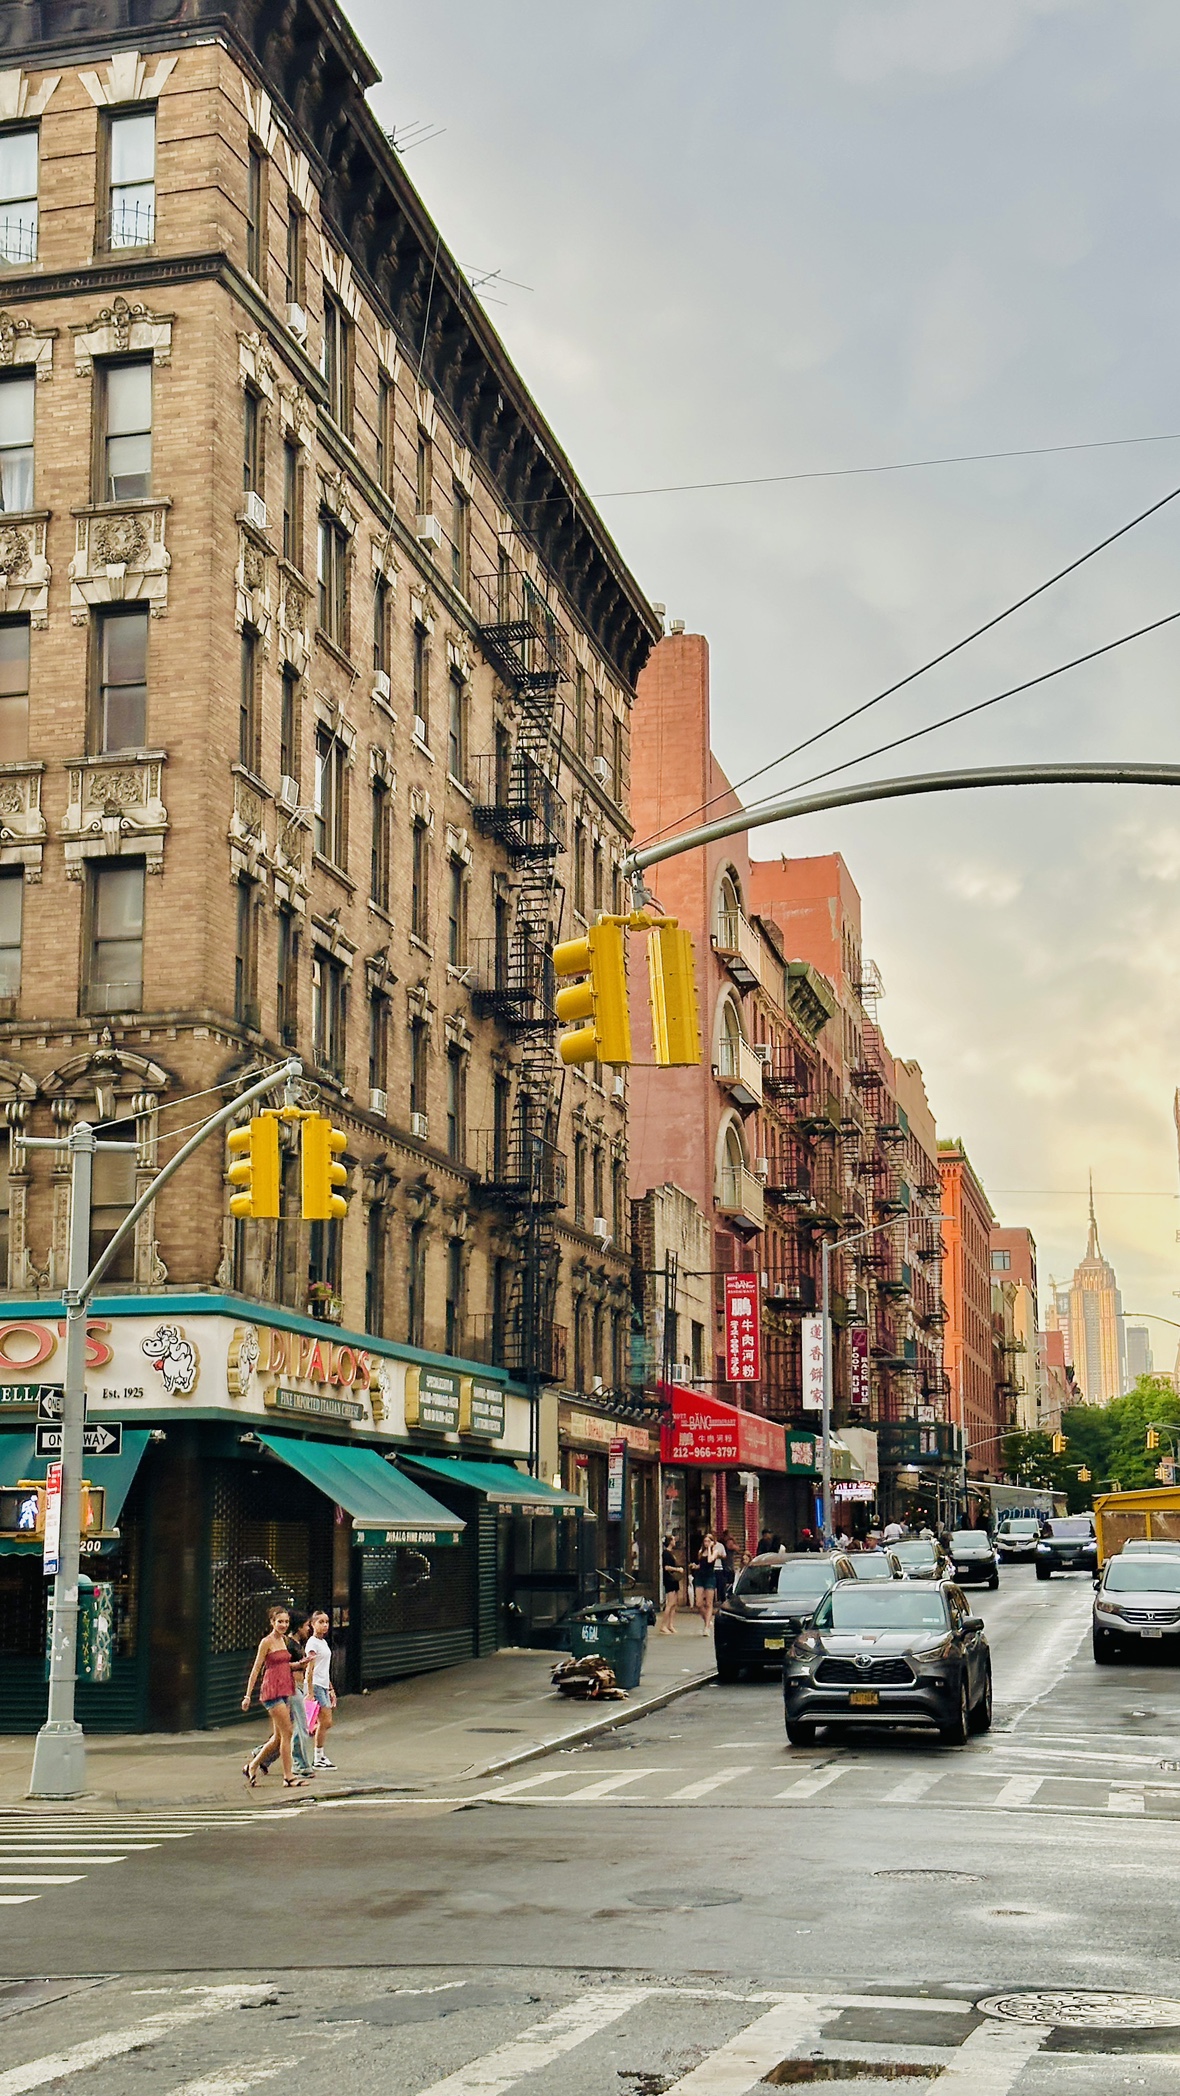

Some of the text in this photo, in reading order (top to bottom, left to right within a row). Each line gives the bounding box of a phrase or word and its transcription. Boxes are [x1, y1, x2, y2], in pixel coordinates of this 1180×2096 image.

[742, 1319, 755, 1378] 牛肉河粉
[268, 1327, 370, 1390] DI PALO'S
[852, 1347, 860, 1393] FOOT RUB
[861, 1357, 869, 1403] BACK RUB
[2, 1387, 40, 1402] ELL
[102, 1387, 144, 1399] Est. 1925
[48, 1397, 61, 1411] ONE
[280, 1391, 293, 1406] FINE
[293, 1394, 320, 1412] IMPORTED
[321, 1399, 341, 1415] ITALIAN
[342, 1403, 359, 1418] CHEESE
[84, 1433, 108, 1445] WAY
[698, 1434, 733, 1443] 牛肉河粉
[673, 1446, 737, 1458] 212-966-3797
[79, 1540, 101, 1552] 200
[581, 1625, 600, 1640] 65 GAL
